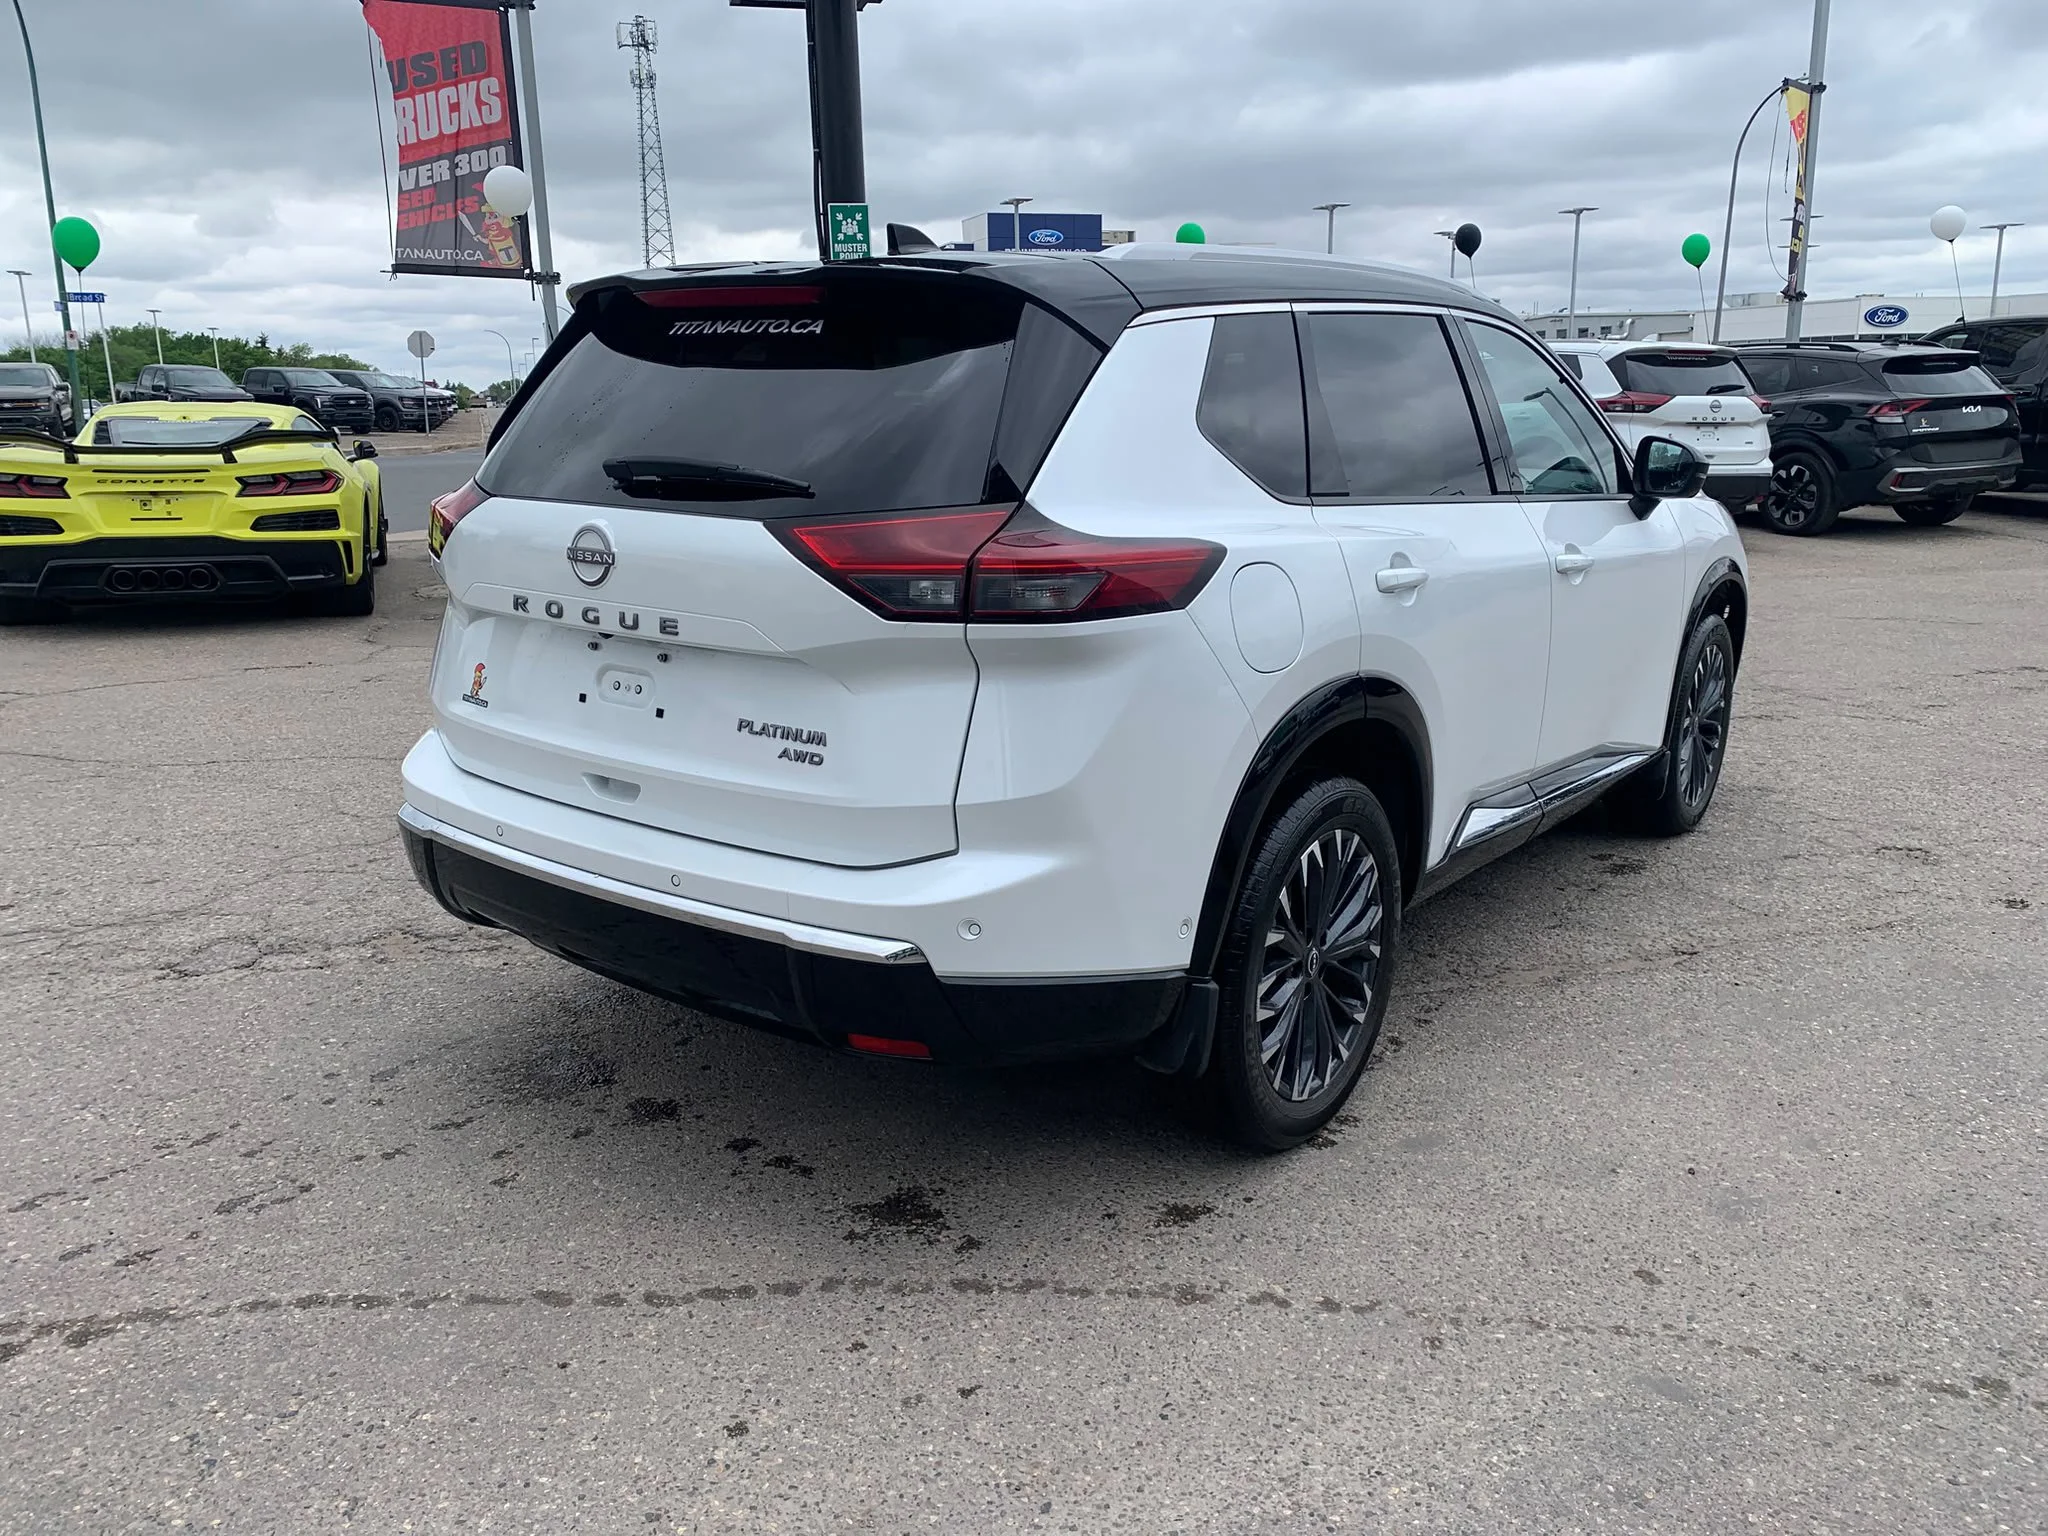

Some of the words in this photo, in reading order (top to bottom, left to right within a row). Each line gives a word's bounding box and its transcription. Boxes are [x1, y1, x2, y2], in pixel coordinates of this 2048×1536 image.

[386, 41, 488, 92] USED
[454, 145, 507, 176] 300
[834, 243, 868, 252] MUSTER
[839, 252, 864, 260] POINT
[69, 293, 93, 302] Broad
[94, 293, 104, 302] St
[668, 318, 825, 335] TITANAUTO.CA
[567, 549, 613, 564] NISSAN
[512, 593, 680, 637] ROGUE
[736, 717, 828, 747] PLATINUM
[777, 747, 825, 766] AWD
